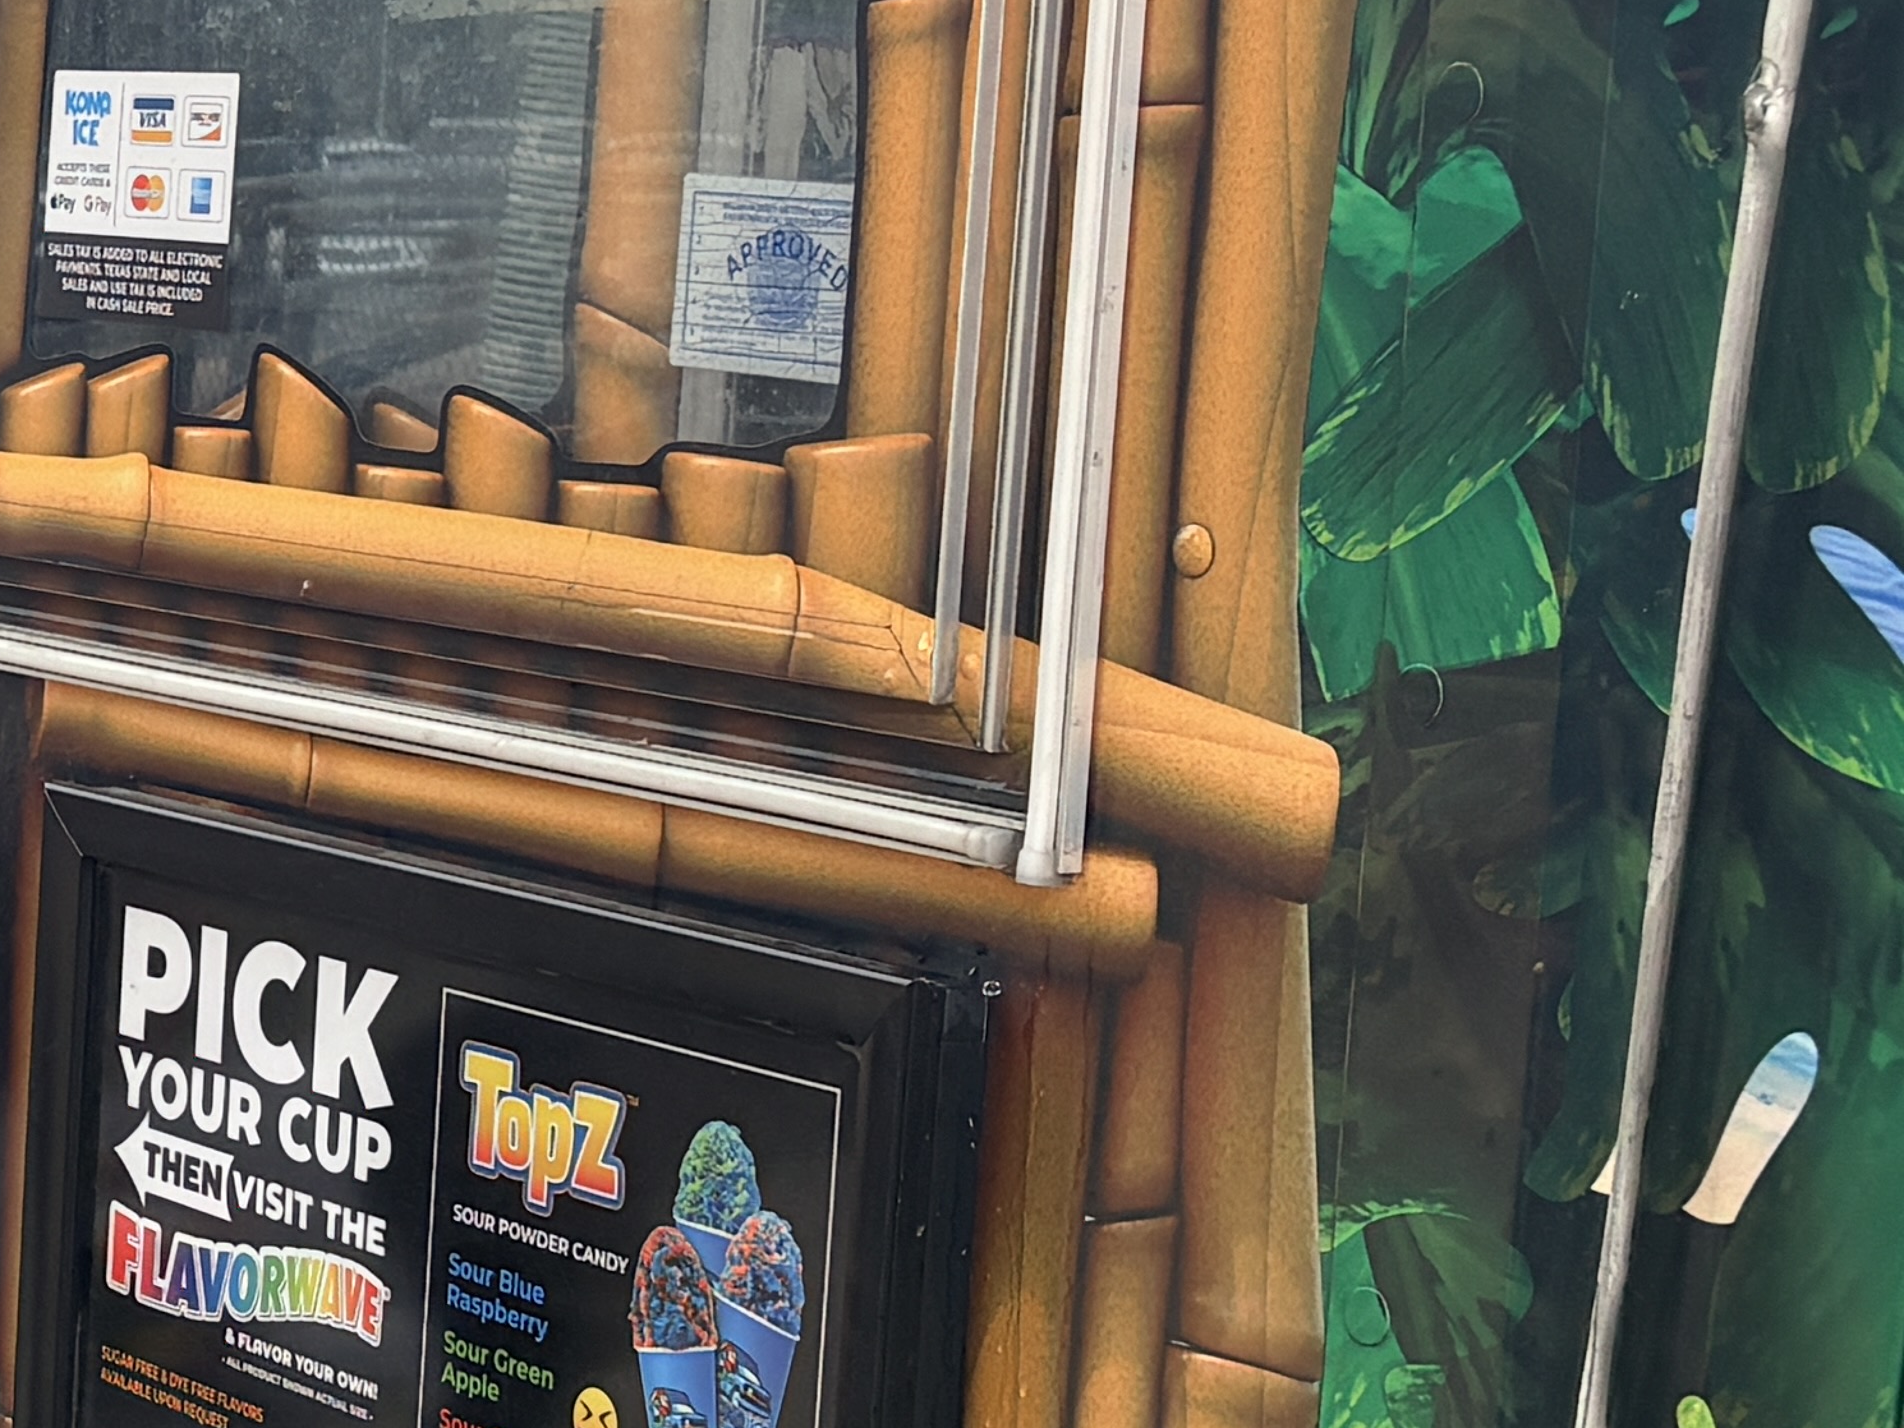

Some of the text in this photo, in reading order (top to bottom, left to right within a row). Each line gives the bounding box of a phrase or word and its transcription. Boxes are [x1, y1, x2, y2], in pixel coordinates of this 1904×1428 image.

[65, 89, 111, 117] KONA
[139, 111, 166, 128] VISA
[72, 120, 100, 146] ICE
[94, 196, 111, 216] Pay
[48, 243, 224, 269] SALES TAX IS ADDED TO ALL ELECTRONIC
[104, 263, 132, 278] TEXAS
[133, 265, 159, 281] STATE
[160, 268, 180, 282] AND
[181, 269, 211, 285] LOCAL
[726, 229, 850, 291] APPROVED
[62, 277, 203, 302] SALES AND USE TAX IS INCLUDED
[86, 296, 96, 310] IN
[96, 297, 121, 312] CASH
[122, 300, 144, 313] SALE
[118, 905, 399, 1110] PICK
[118, 1044, 392, 1182] YOUR CUP
[143, 1140, 387, 1257] THEN VISIT THE
[452, 1203, 630, 1275] SOUR POWDER CANDY
[448, 1252, 546, 1306] Sour Blue
[446, 1281, 549, 1343] Raspberry
[101, 1345, 134, 1371] SUGAR
[135, 1356, 159, 1379] FREE
[169, 1372, 189, 1392] DYE
[191, 1381, 215, 1405] FREE
[216, 1391, 265, 1423] FLAVORS
[224, 1327, 379, 1400] & FLAVOR YOUR OWN!
[440, 1363, 500, 1404] Apple
[442, 1329, 555, 1390] Sour Green
[100, 1367, 152, 1401] AVAILABLE
[153, 1388, 182, 1413] UPON
